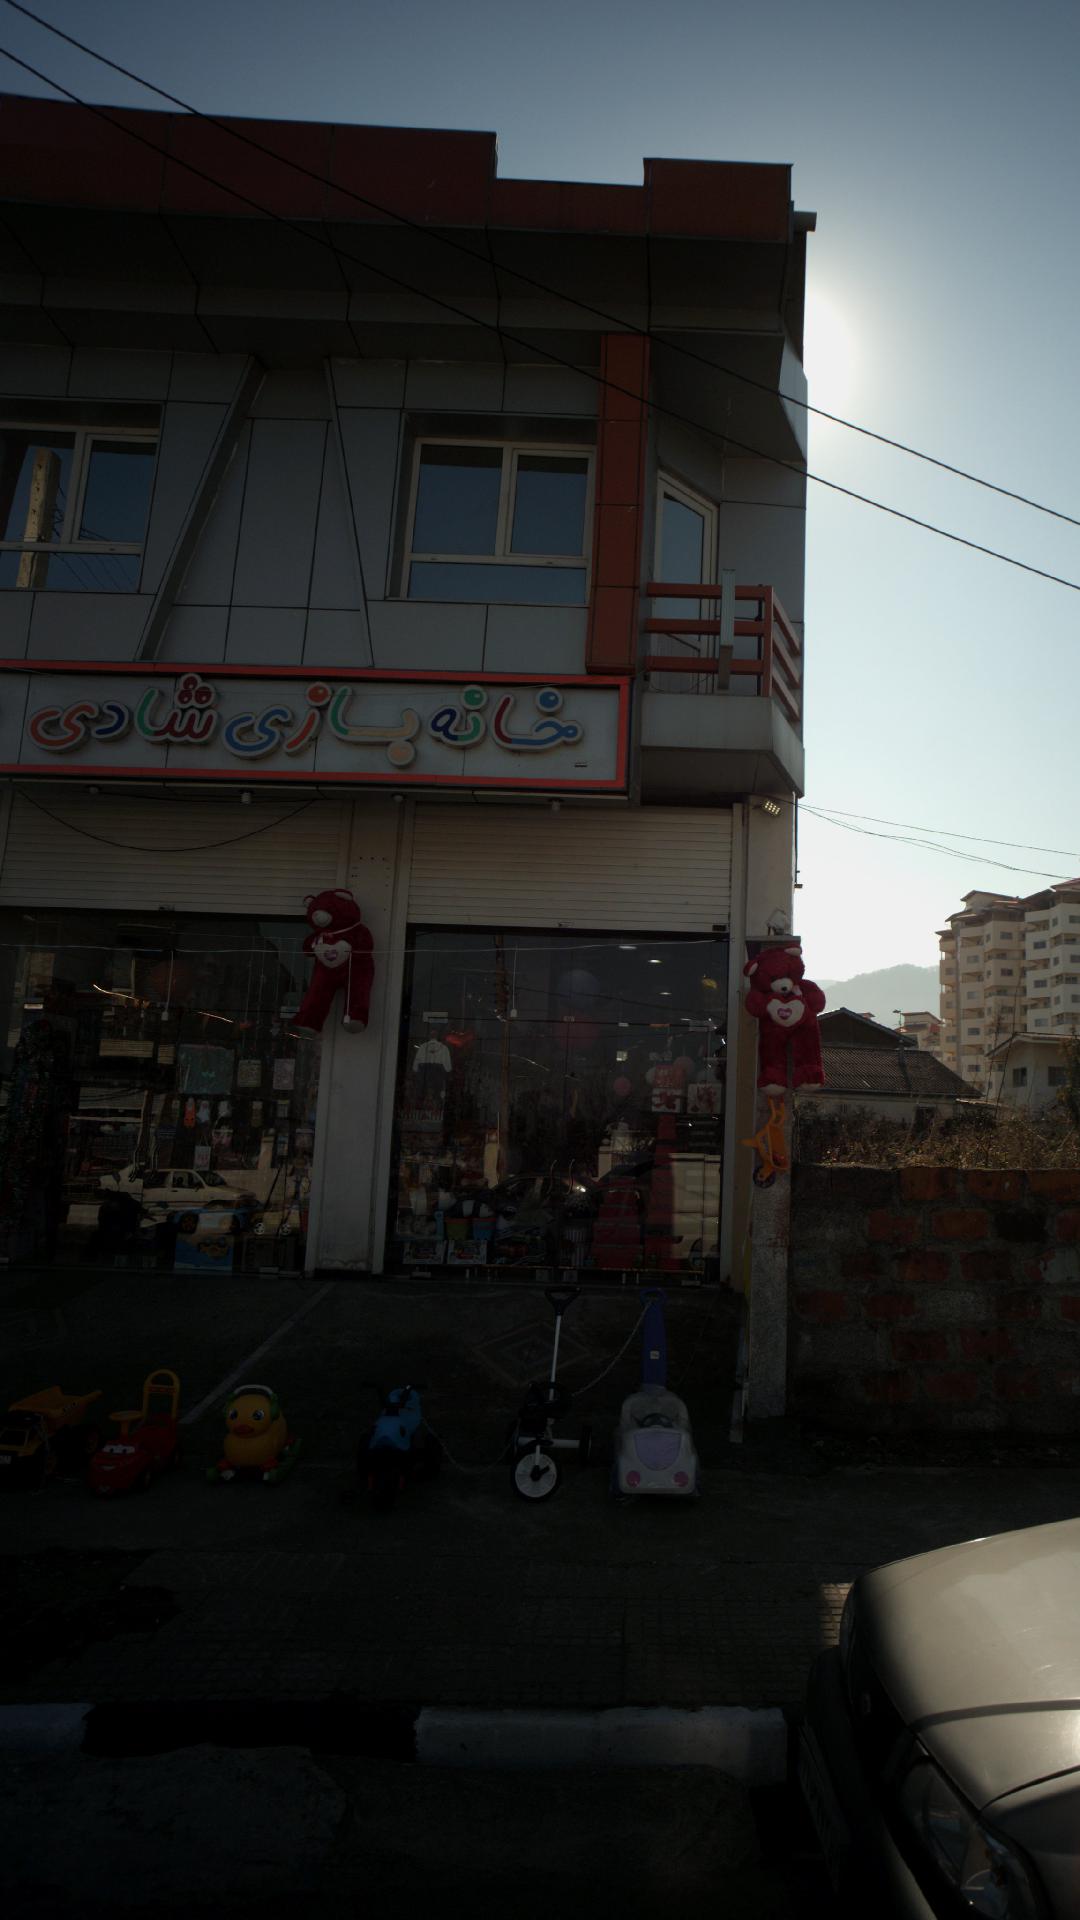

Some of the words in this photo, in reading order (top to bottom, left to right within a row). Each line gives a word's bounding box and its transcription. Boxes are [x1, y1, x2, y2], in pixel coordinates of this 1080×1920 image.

[29, 673, 218, 751] شادی
[224, 682, 418, 767] بازی
[429, 685, 582, 750] خانه
